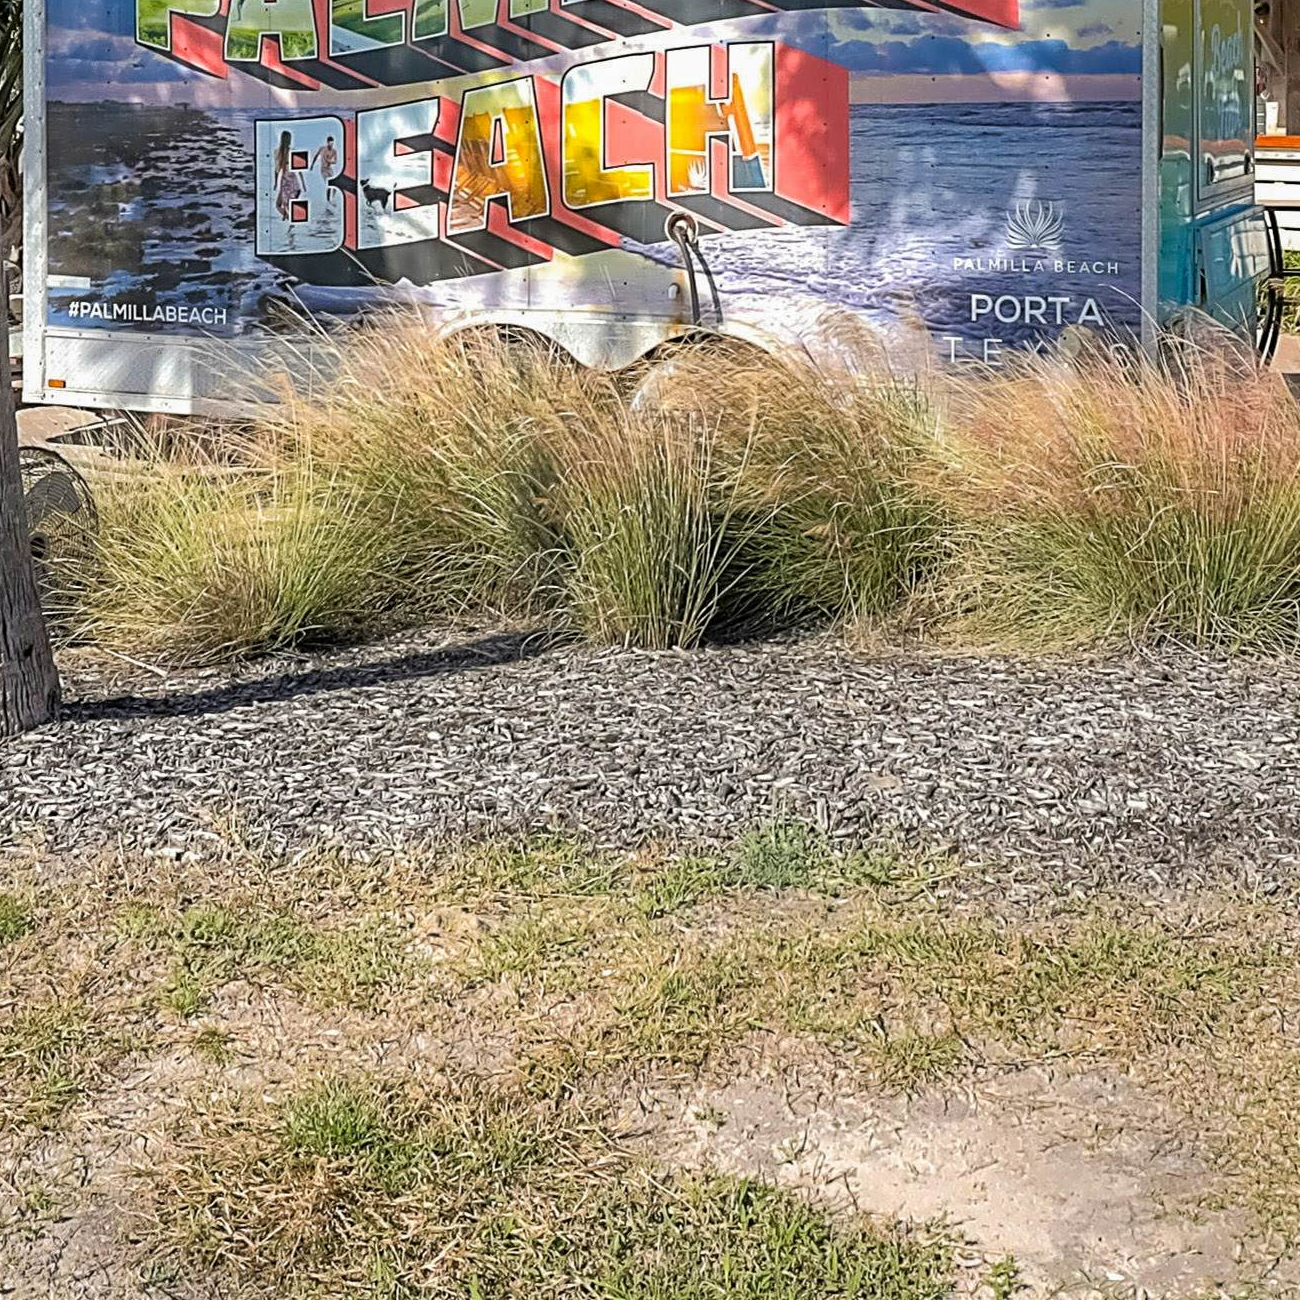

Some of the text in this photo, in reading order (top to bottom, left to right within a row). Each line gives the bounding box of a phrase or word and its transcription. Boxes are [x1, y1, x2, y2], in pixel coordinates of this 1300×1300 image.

[255, 40, 777, 257] BEACH
[953, 257, 1119, 274] PALMILLA BEACH
[68, 301, 228, 325] #PALMILLABEACH
[970, 293, 1105, 327] PORT A
